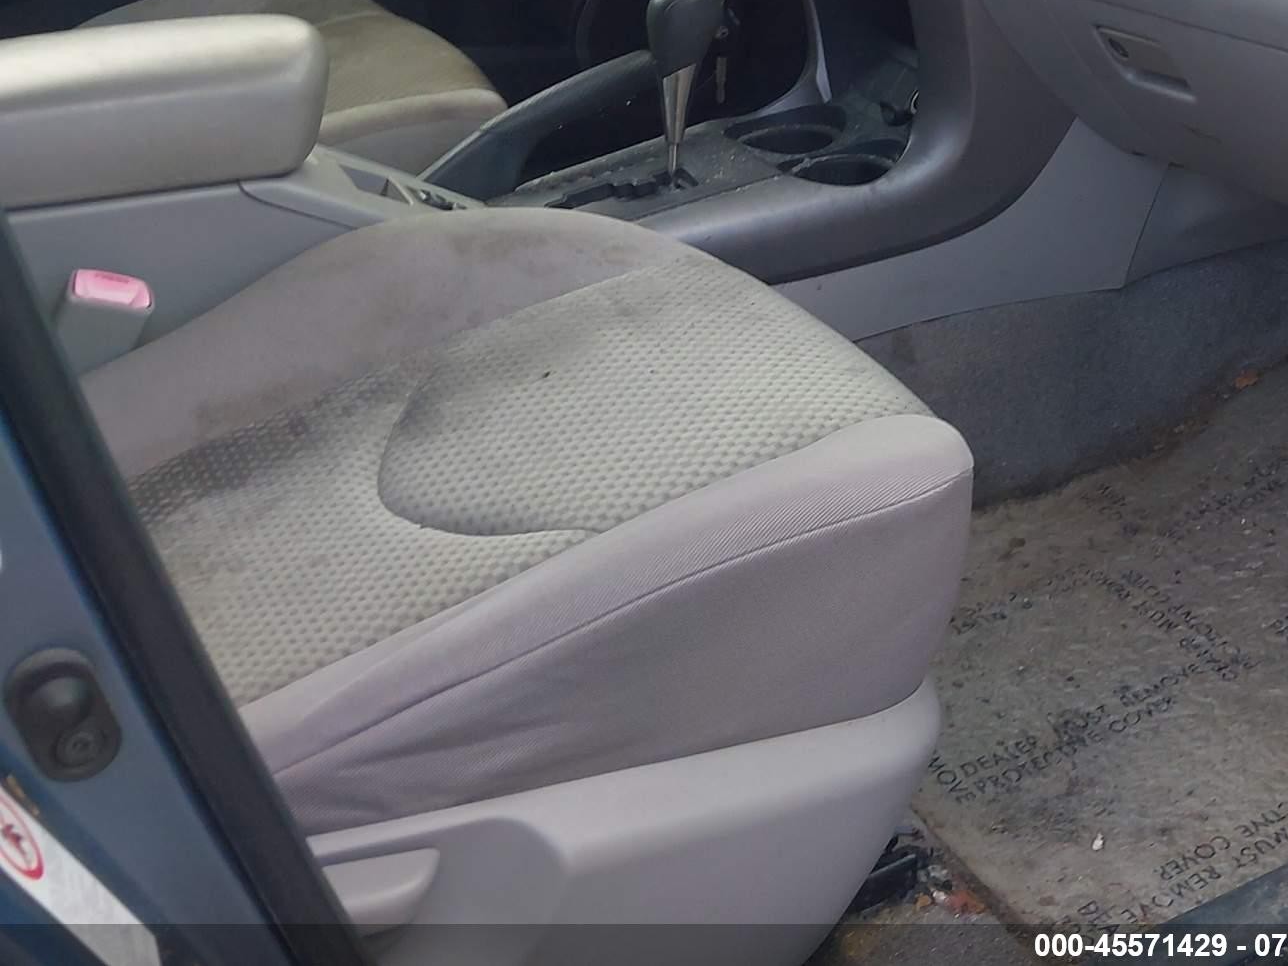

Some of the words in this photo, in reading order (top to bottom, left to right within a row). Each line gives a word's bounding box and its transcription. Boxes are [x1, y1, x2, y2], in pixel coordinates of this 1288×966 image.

[1108, 695, 1177, 734] COVER
[959, 734, 1038, 779] DEALER
[1120, 864, 1223, 925] REMOVE
